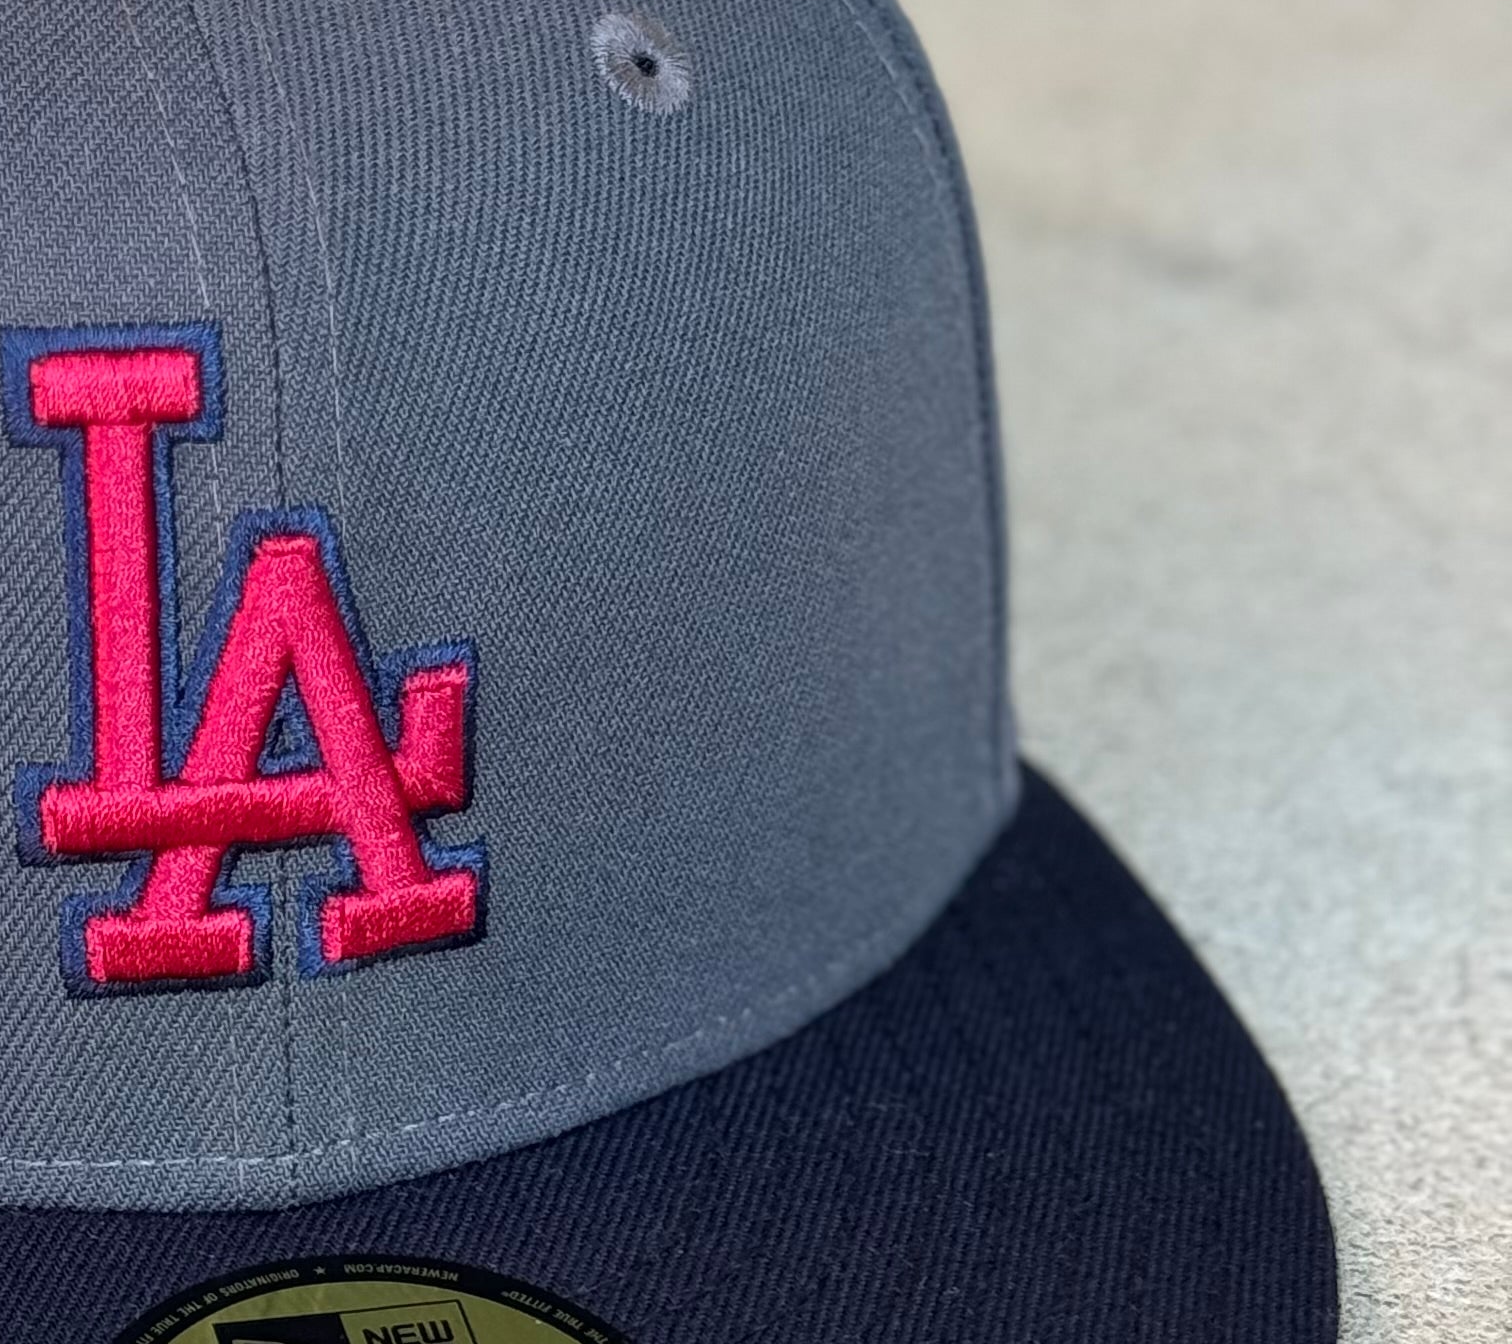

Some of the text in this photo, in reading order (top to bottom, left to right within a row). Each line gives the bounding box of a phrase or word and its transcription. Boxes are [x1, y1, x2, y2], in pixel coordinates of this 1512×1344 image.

[0, 324, 489, 998] LA
[219, 1269, 300, 1297] ORIGINATORS
[176, 1300, 203, 1318] THE
[203, 1292, 218, 1306] OF
[150, 1313, 180, 1336] TRUE
[551, 1309, 584, 1331] TRUE
